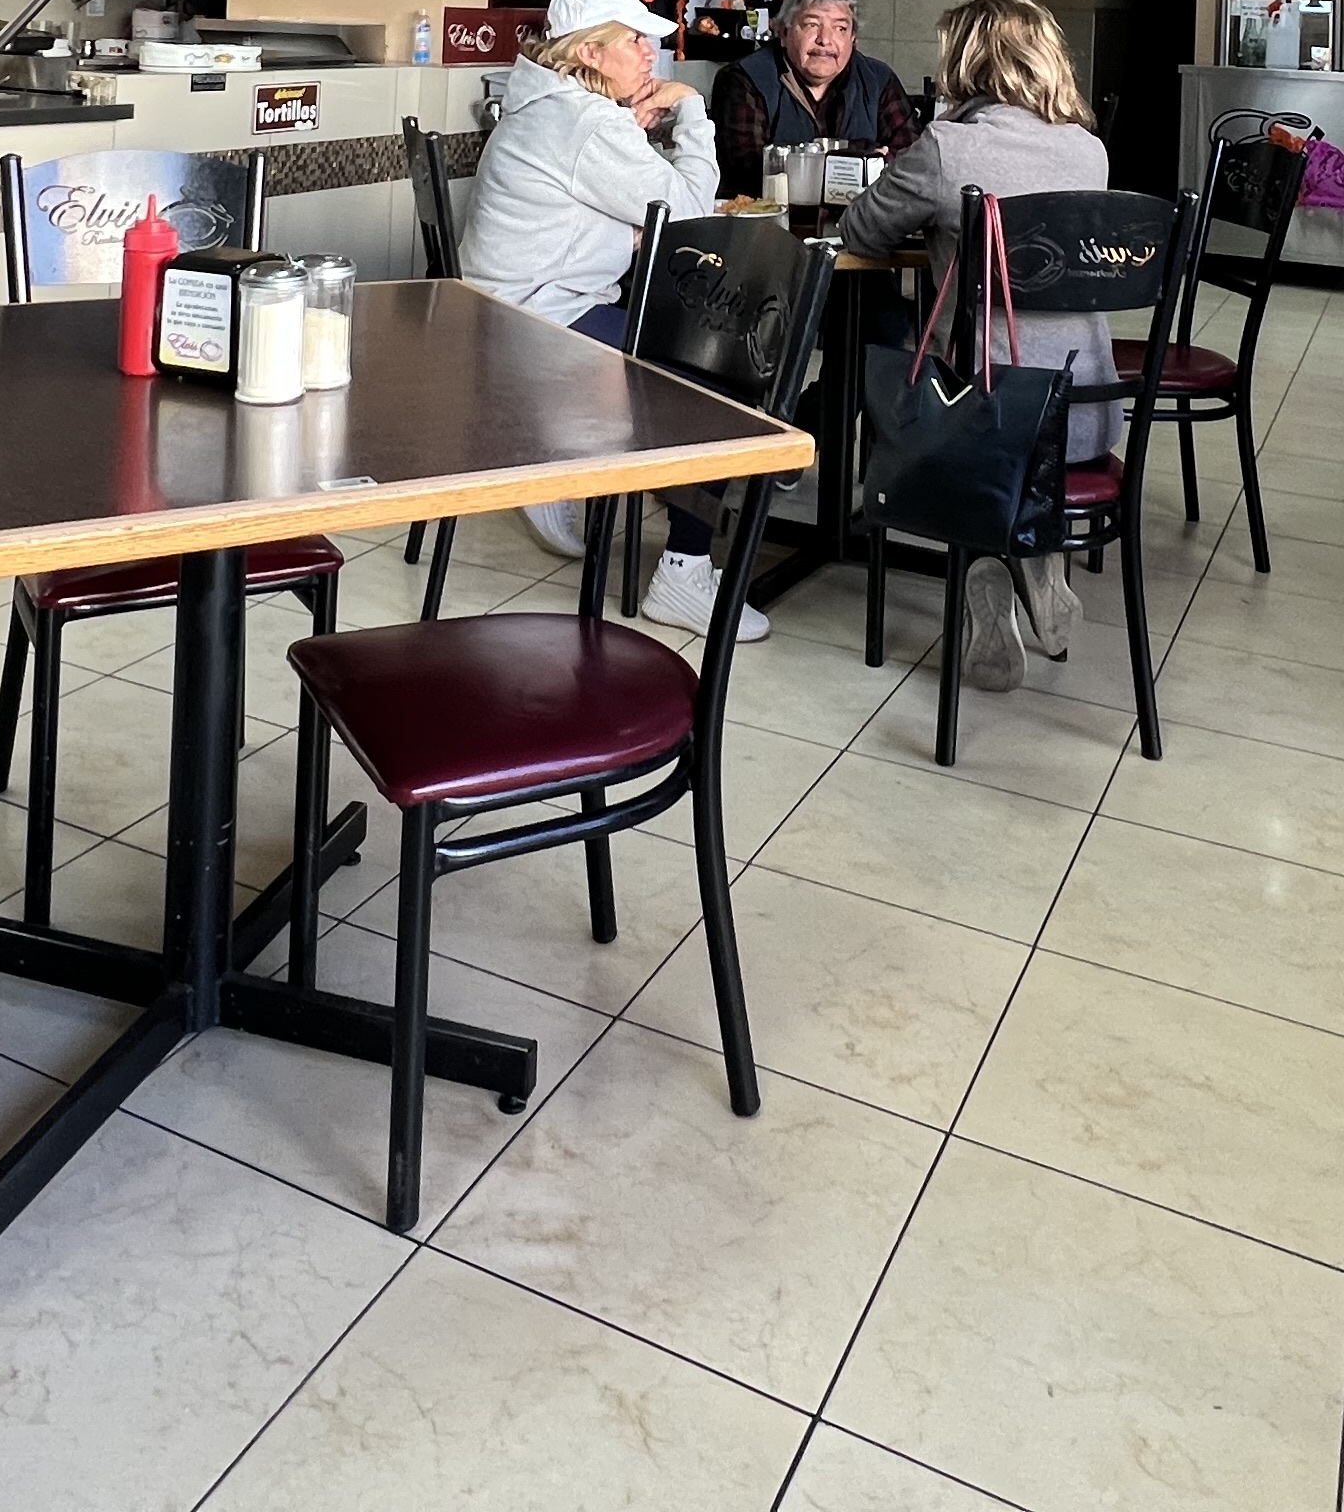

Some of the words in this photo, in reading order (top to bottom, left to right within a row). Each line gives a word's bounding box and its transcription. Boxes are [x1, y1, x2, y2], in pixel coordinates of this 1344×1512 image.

[256, 98, 317, 124] Tortillas
[36, 185, 141, 234] Elvis
[178, 277, 205, 287] COMIDA
